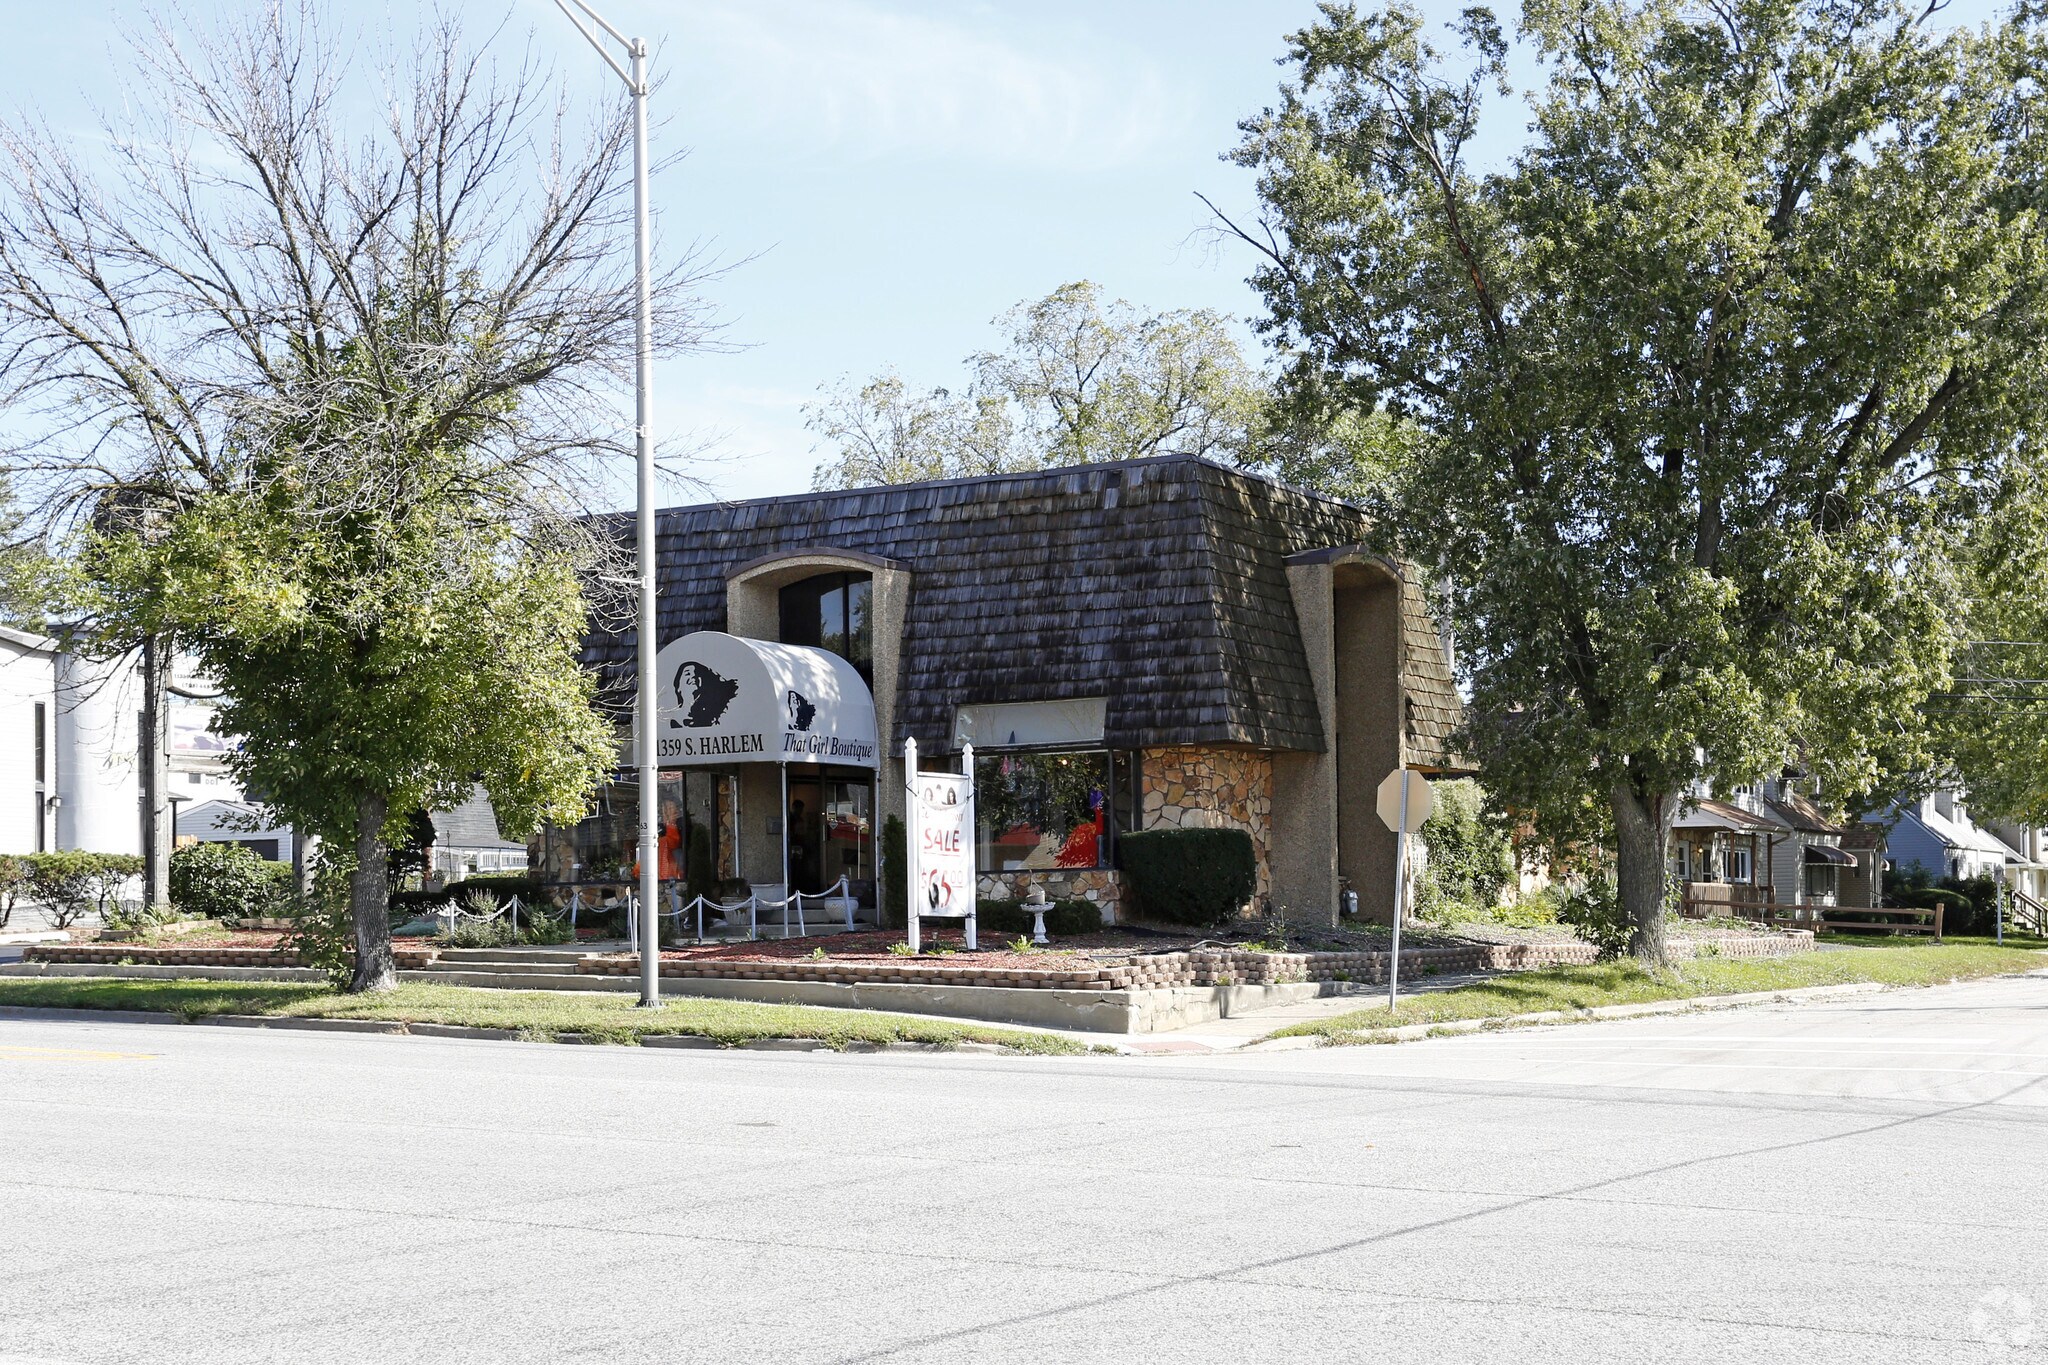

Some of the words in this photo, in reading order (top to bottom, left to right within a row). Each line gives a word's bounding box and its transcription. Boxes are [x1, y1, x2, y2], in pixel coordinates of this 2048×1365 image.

[685, 737, 697, 756] S.
[700, 733, 764, 755] HARLEM
[783, 732, 807, 753] That
[808, 734, 829, 755] Girl
[829, 736, 873, 762] Boutique
[923, 827, 961, 853] SALE
